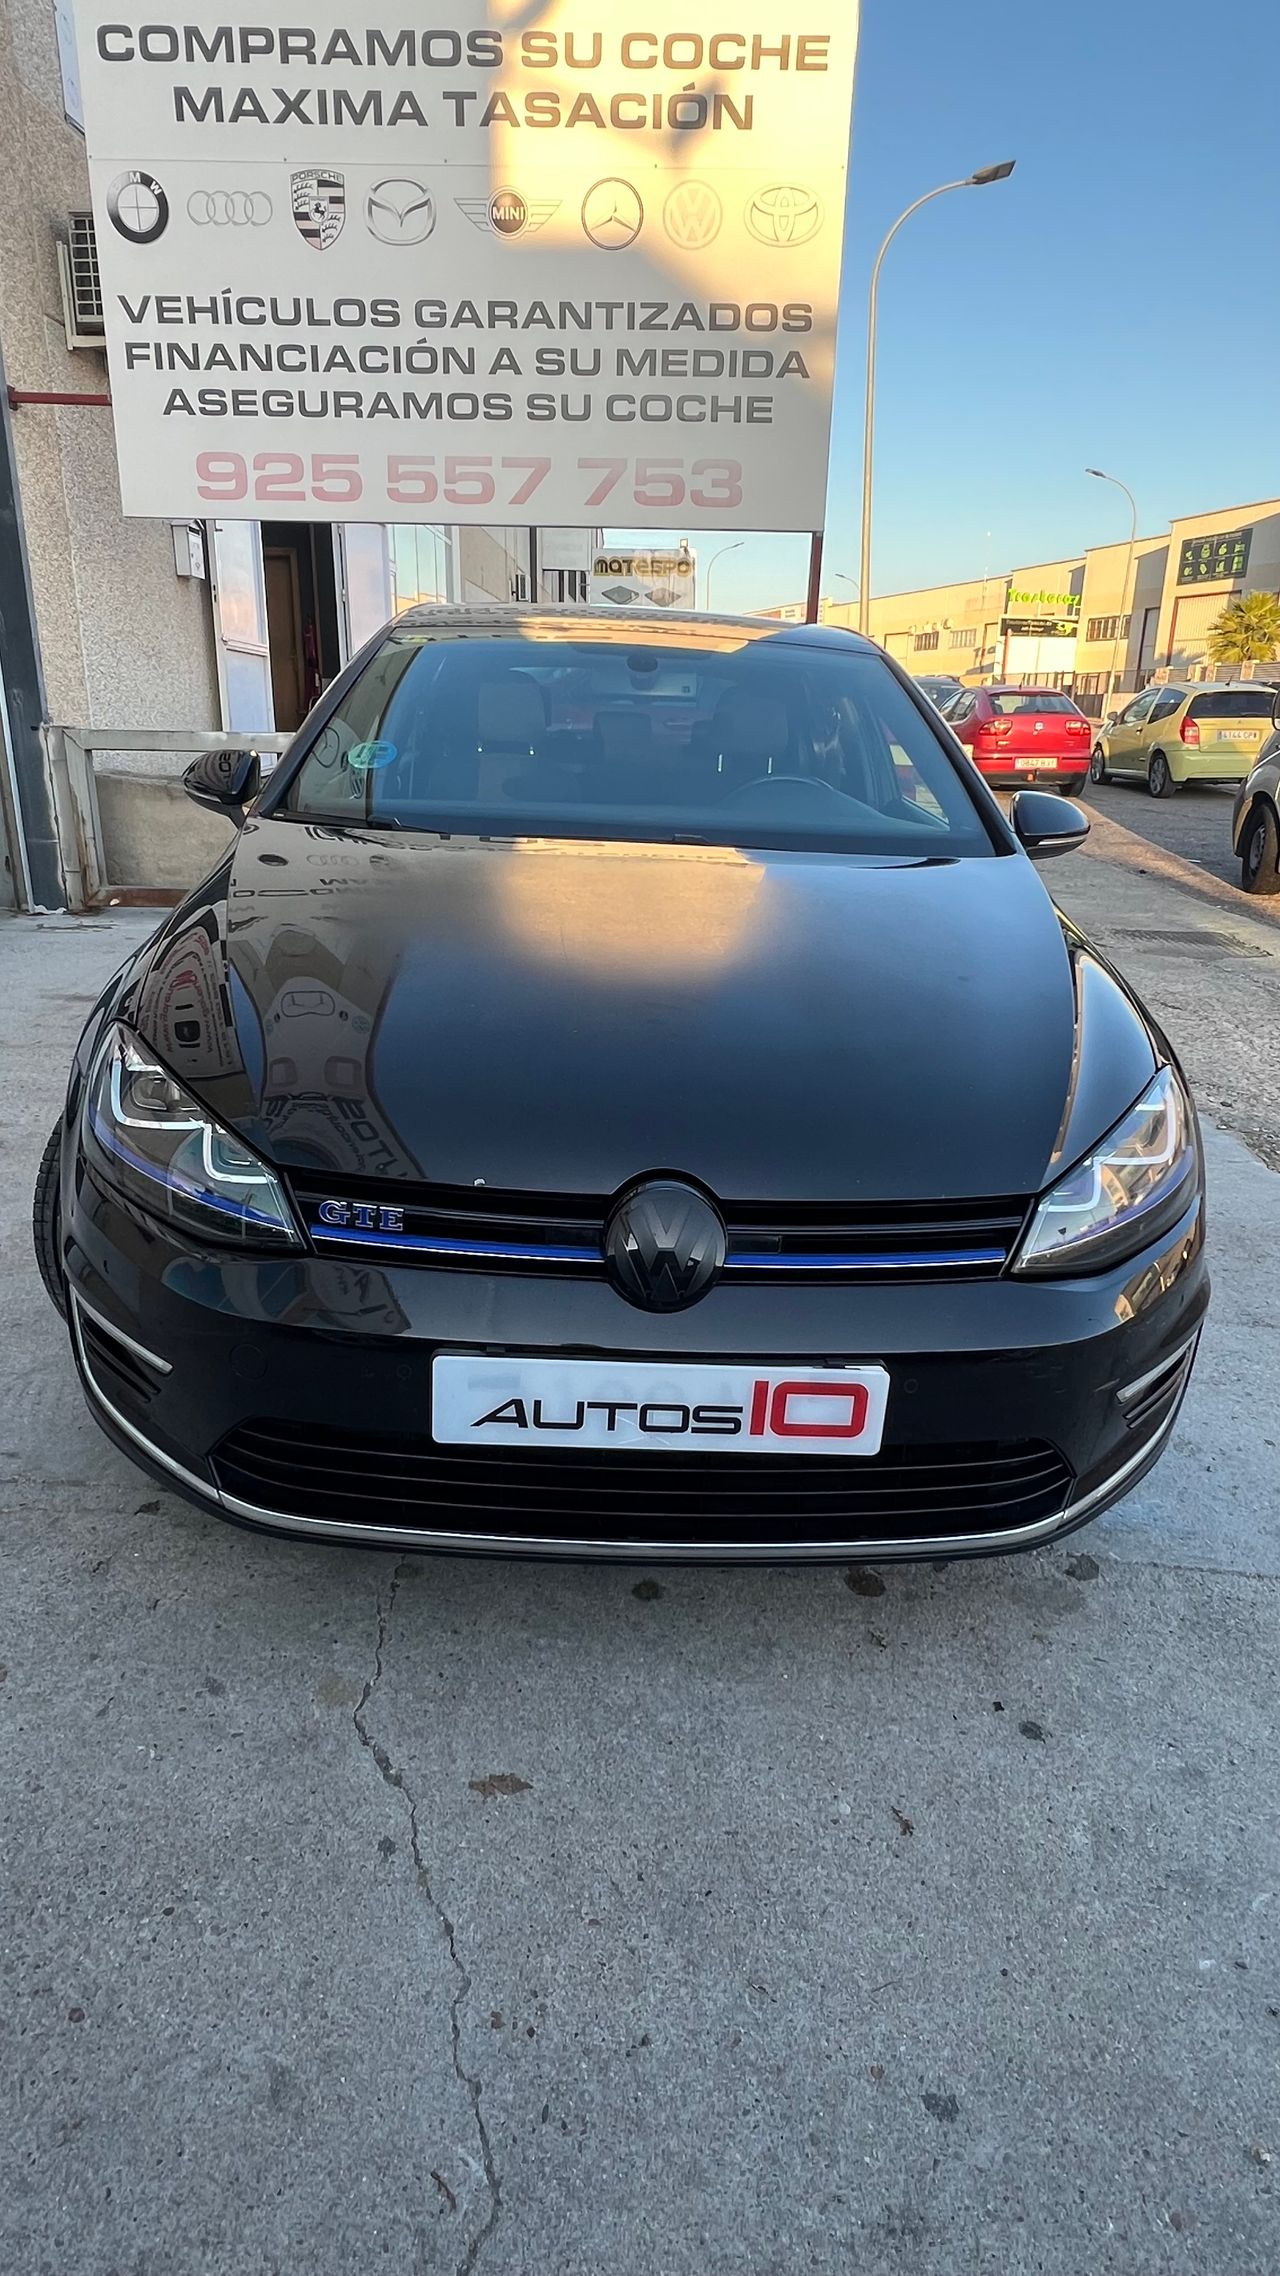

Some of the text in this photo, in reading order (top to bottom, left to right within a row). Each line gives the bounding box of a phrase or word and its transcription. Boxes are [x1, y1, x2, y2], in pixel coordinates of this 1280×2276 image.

[96, 23, 831, 72] COMPRAMOS SU COCHE
[172, 82, 754, 131] MAXIMA TASACIÓN
[491, 206, 526, 222] MINI
[116, 287, 813, 333] VEHÍCULOS GARANTIZADOS
[124, 337, 811, 379] FINANCIACIÓN A SU MEDIDA
[162, 388, 774, 424] ASEGURAMOS SU COCHE
[196, 451, 744, 509] 925 557 753
[319, 1200, 404, 1231] GTE
[470, 1379, 869, 1439] AUTOS10
